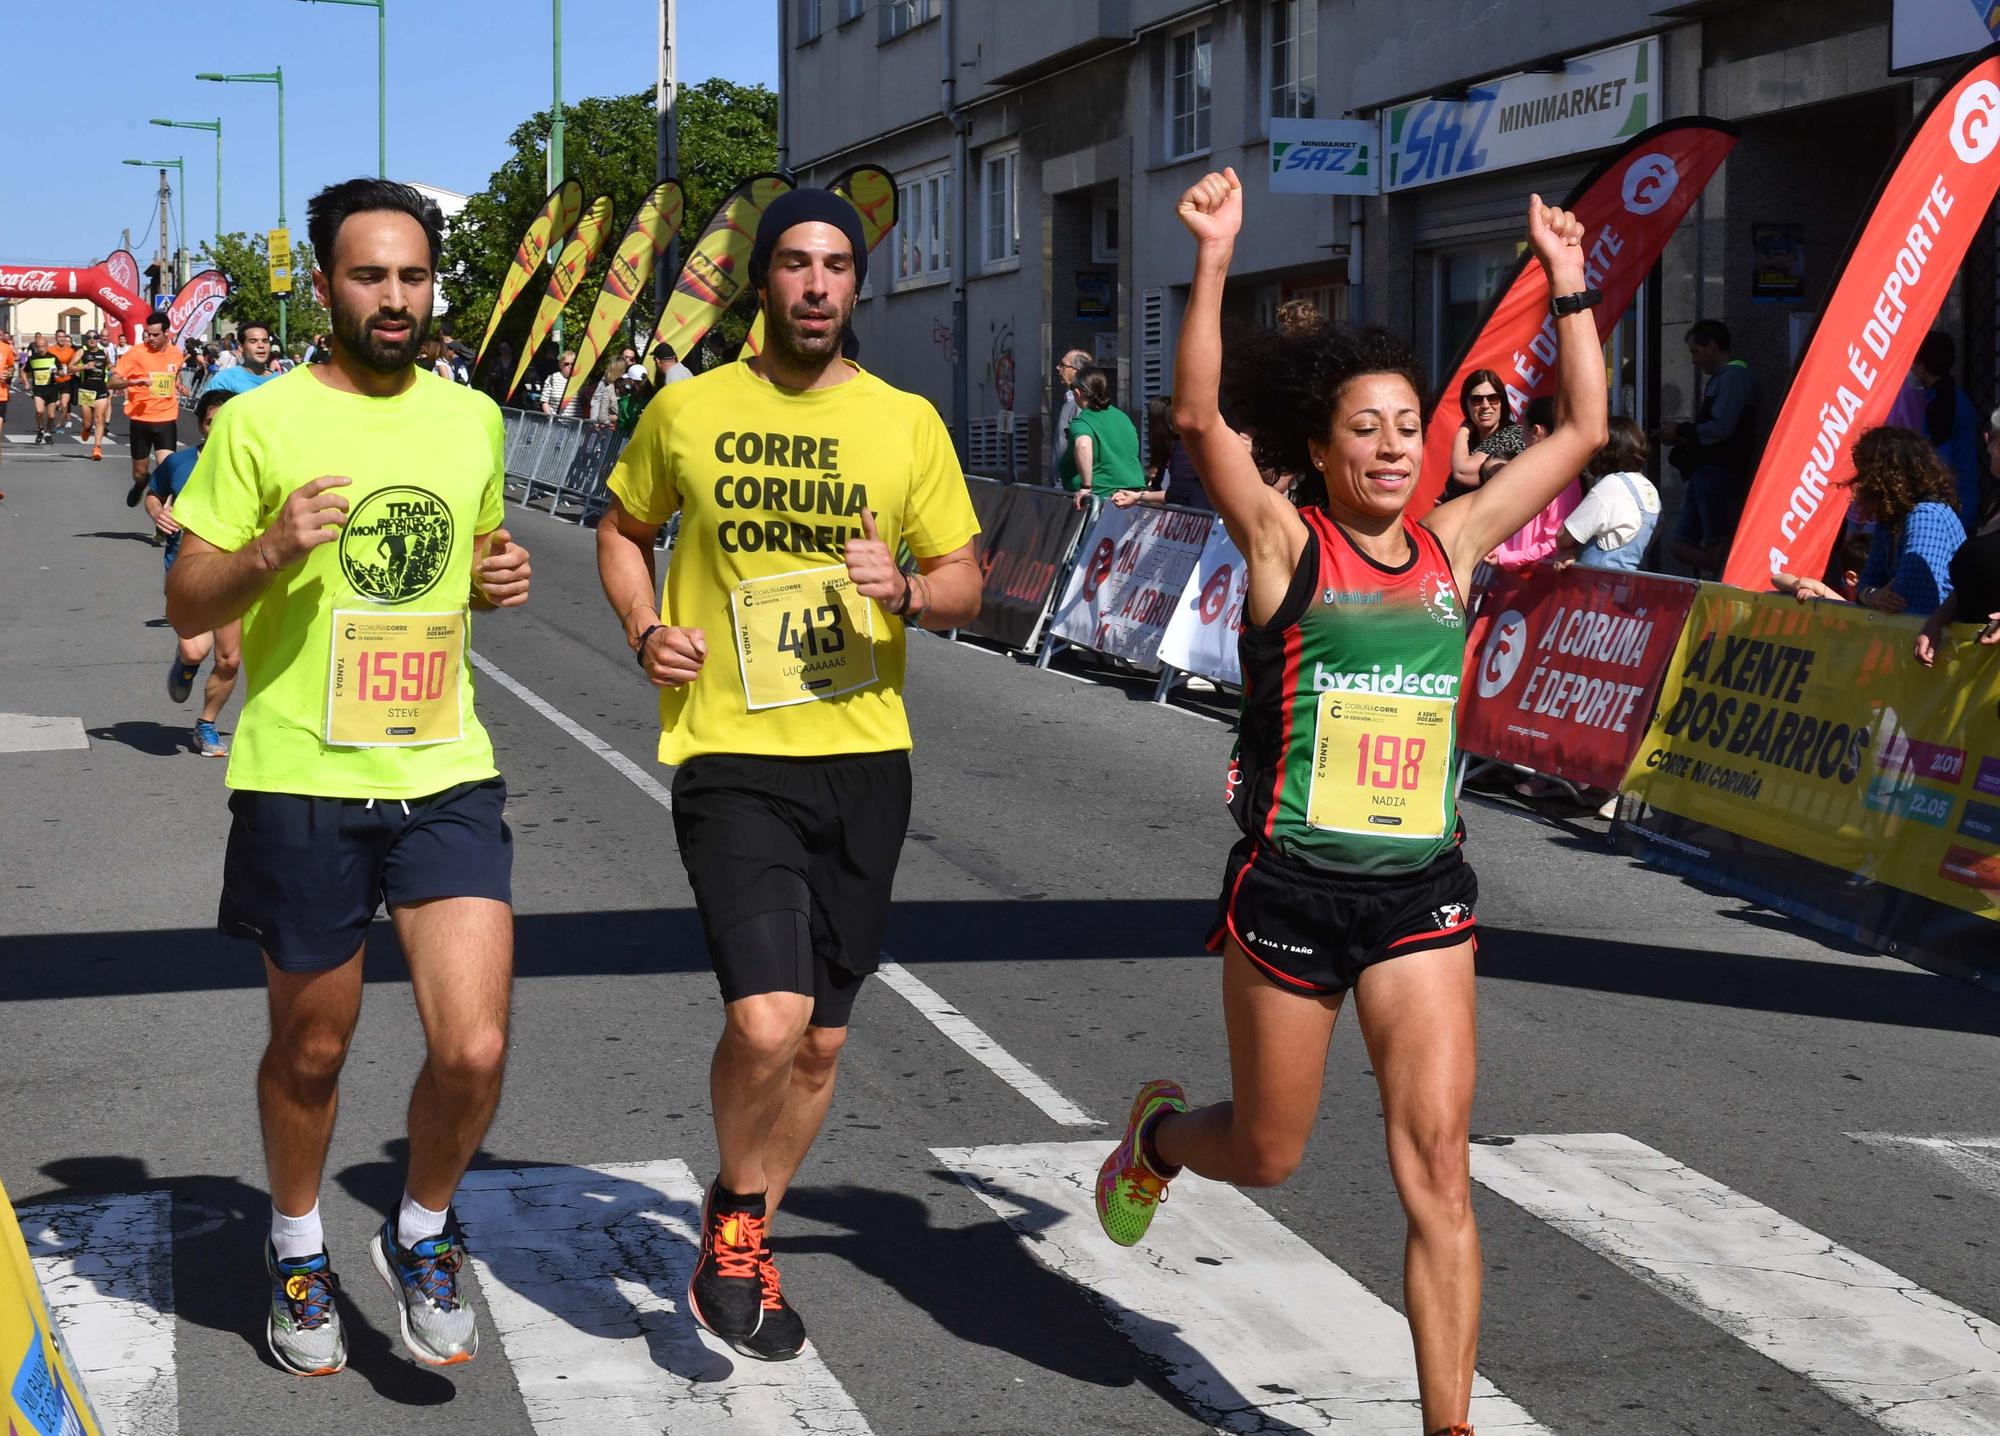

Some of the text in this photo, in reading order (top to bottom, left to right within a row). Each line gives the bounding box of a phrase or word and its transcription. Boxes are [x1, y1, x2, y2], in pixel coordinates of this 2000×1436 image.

[1301, 140, 1358, 149] MINIMARKET
[1402, 78, 1627, 184] SAZ MINIMARKET
[1284, 147, 1354, 171] SAZ
[688, 255, 738, 298] GADIS
[1862, 174, 1955, 361] DEPORTE
[1847, 342, 1878, 391] É
[714, 431, 840, 470] CORRE
[1779, 384, 1864, 544] CORUÑA
[350, 522, 433, 537] MONTE PINDO
[386, 500, 441, 518] TRAIL
[741, 625, 751, 656] TANDA
[777, 604, 845, 659] 413
[1538, 607, 1654, 668] A CORUÑA
[336, 658, 345, 689] TANDA
[357, 651, 448, 702] 1590
[1682, 631, 1817, 704] A XENTE
[388, 708, 420, 718] STEVE
[1518, 656, 1644, 733] É DEPORTE
[1318, 737, 1329, 769] TANDA
[1664, 686, 1870, 785] DOS BARRIOS
[1357, 733, 1426, 790] 198
[1371, 795, 1406, 807] NADIA
[1708, 766, 1763, 800] CORUÑA
[1258, 938, 1278, 949] CASA
[1290, 945, 1313, 955] BAÑO
